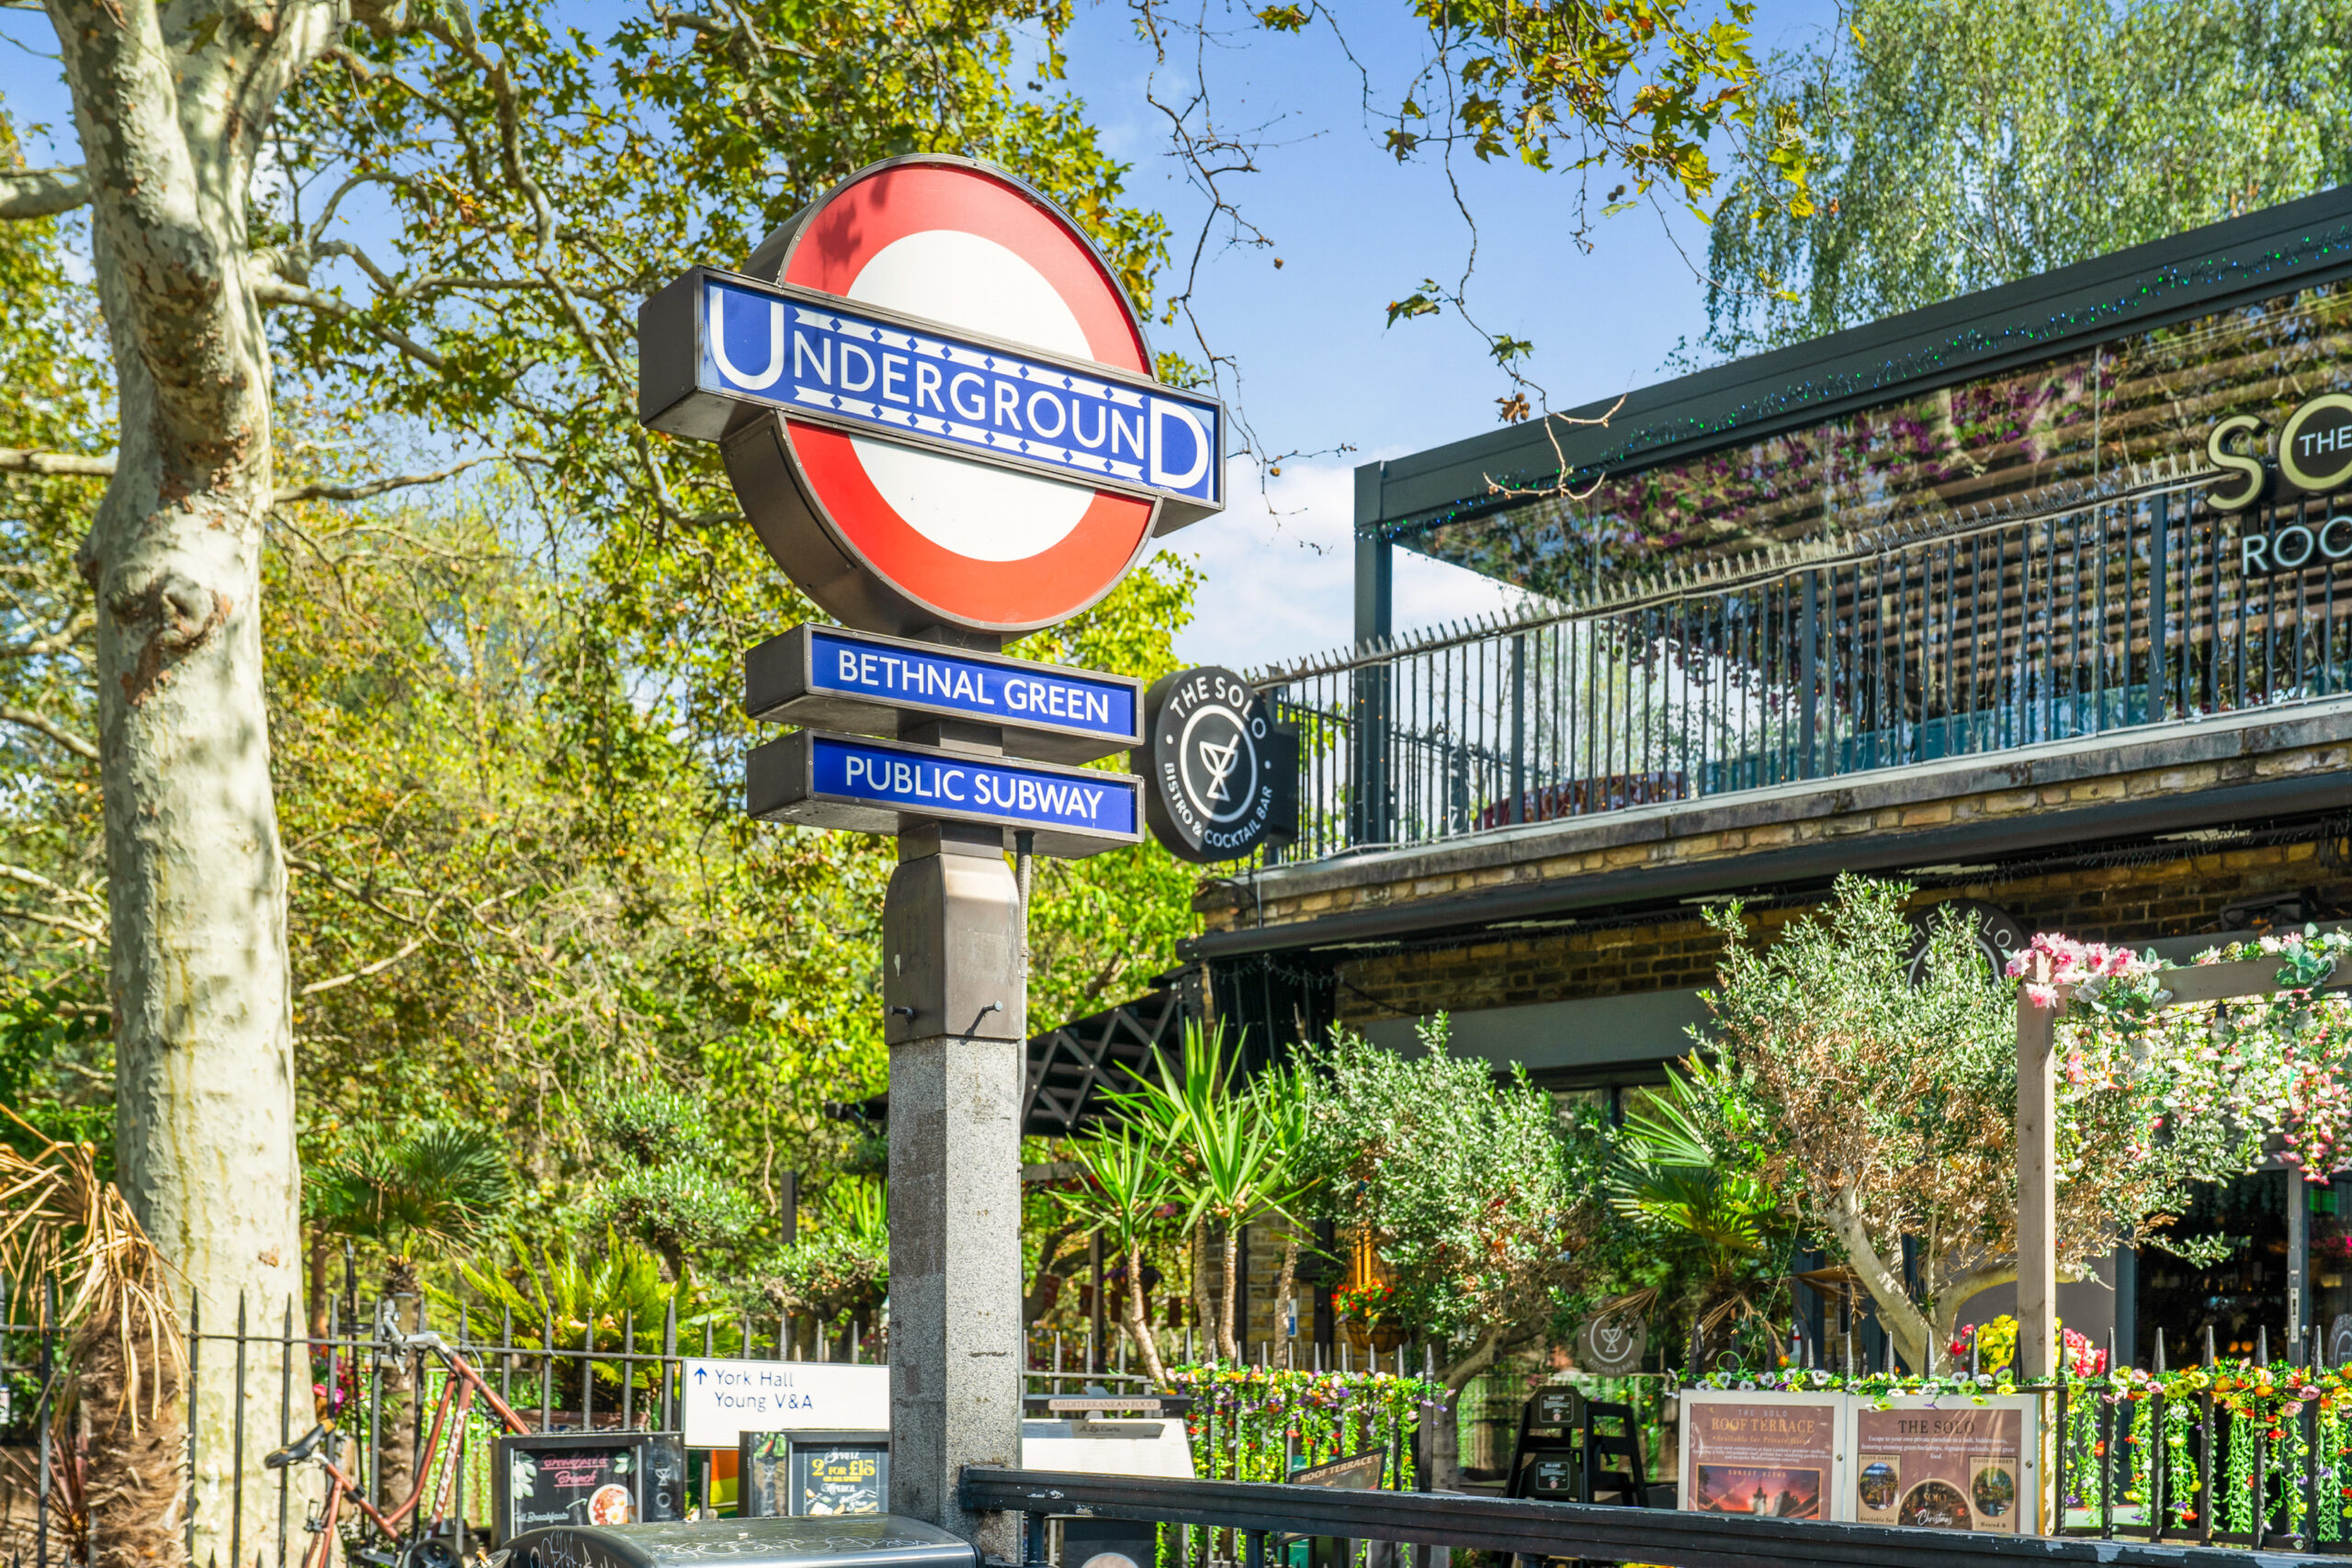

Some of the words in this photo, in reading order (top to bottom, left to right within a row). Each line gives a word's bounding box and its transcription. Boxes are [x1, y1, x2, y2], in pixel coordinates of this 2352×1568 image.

[708, 285, 1209, 490] UNDERGROUND
[2298, 424, 2352, 457] THE
[2242, 514, 2352, 576] ROO
[838, 649, 995, 706] BETHNAL
[1003, 678, 1110, 725] GREEN
[1170, 675, 1210, 718] THE
[1215, 675, 1267, 739] SOLO
[845, 754, 966, 803] PUBLIC
[974, 773, 1104, 820] SUBWAY
[1163, 761, 1193, 825] BISTRO
[1192, 820, 1202, 838] &
[1204, 818, 1261, 850] COCKTAIL
[1255, 784, 1273, 821] BAR
[715, 1369, 752, 1386] York
[760, 1371, 794, 1388] Hall
[714, 1392, 766, 1413] Young
[775, 1393, 813, 1410] V&A
[1738, 1409, 1754, 1417] THE
[1712, 1417, 1747, 1432] ROOF
[1750, 1418, 1815, 1434] TERRACE
[1898, 1420, 1928, 1434] THE
[1934, 1421, 1974, 1434] SOLO
[811, 1459, 825, 1476] 2
[828, 1466, 847, 1475] FOR
[849, 1460, 876, 1476] £15
[1300, 1470, 1328, 1483] ROOF
[1329, 1456, 1373, 1475] TERRACE
[1917, 1509, 1953, 1526] Christmas
